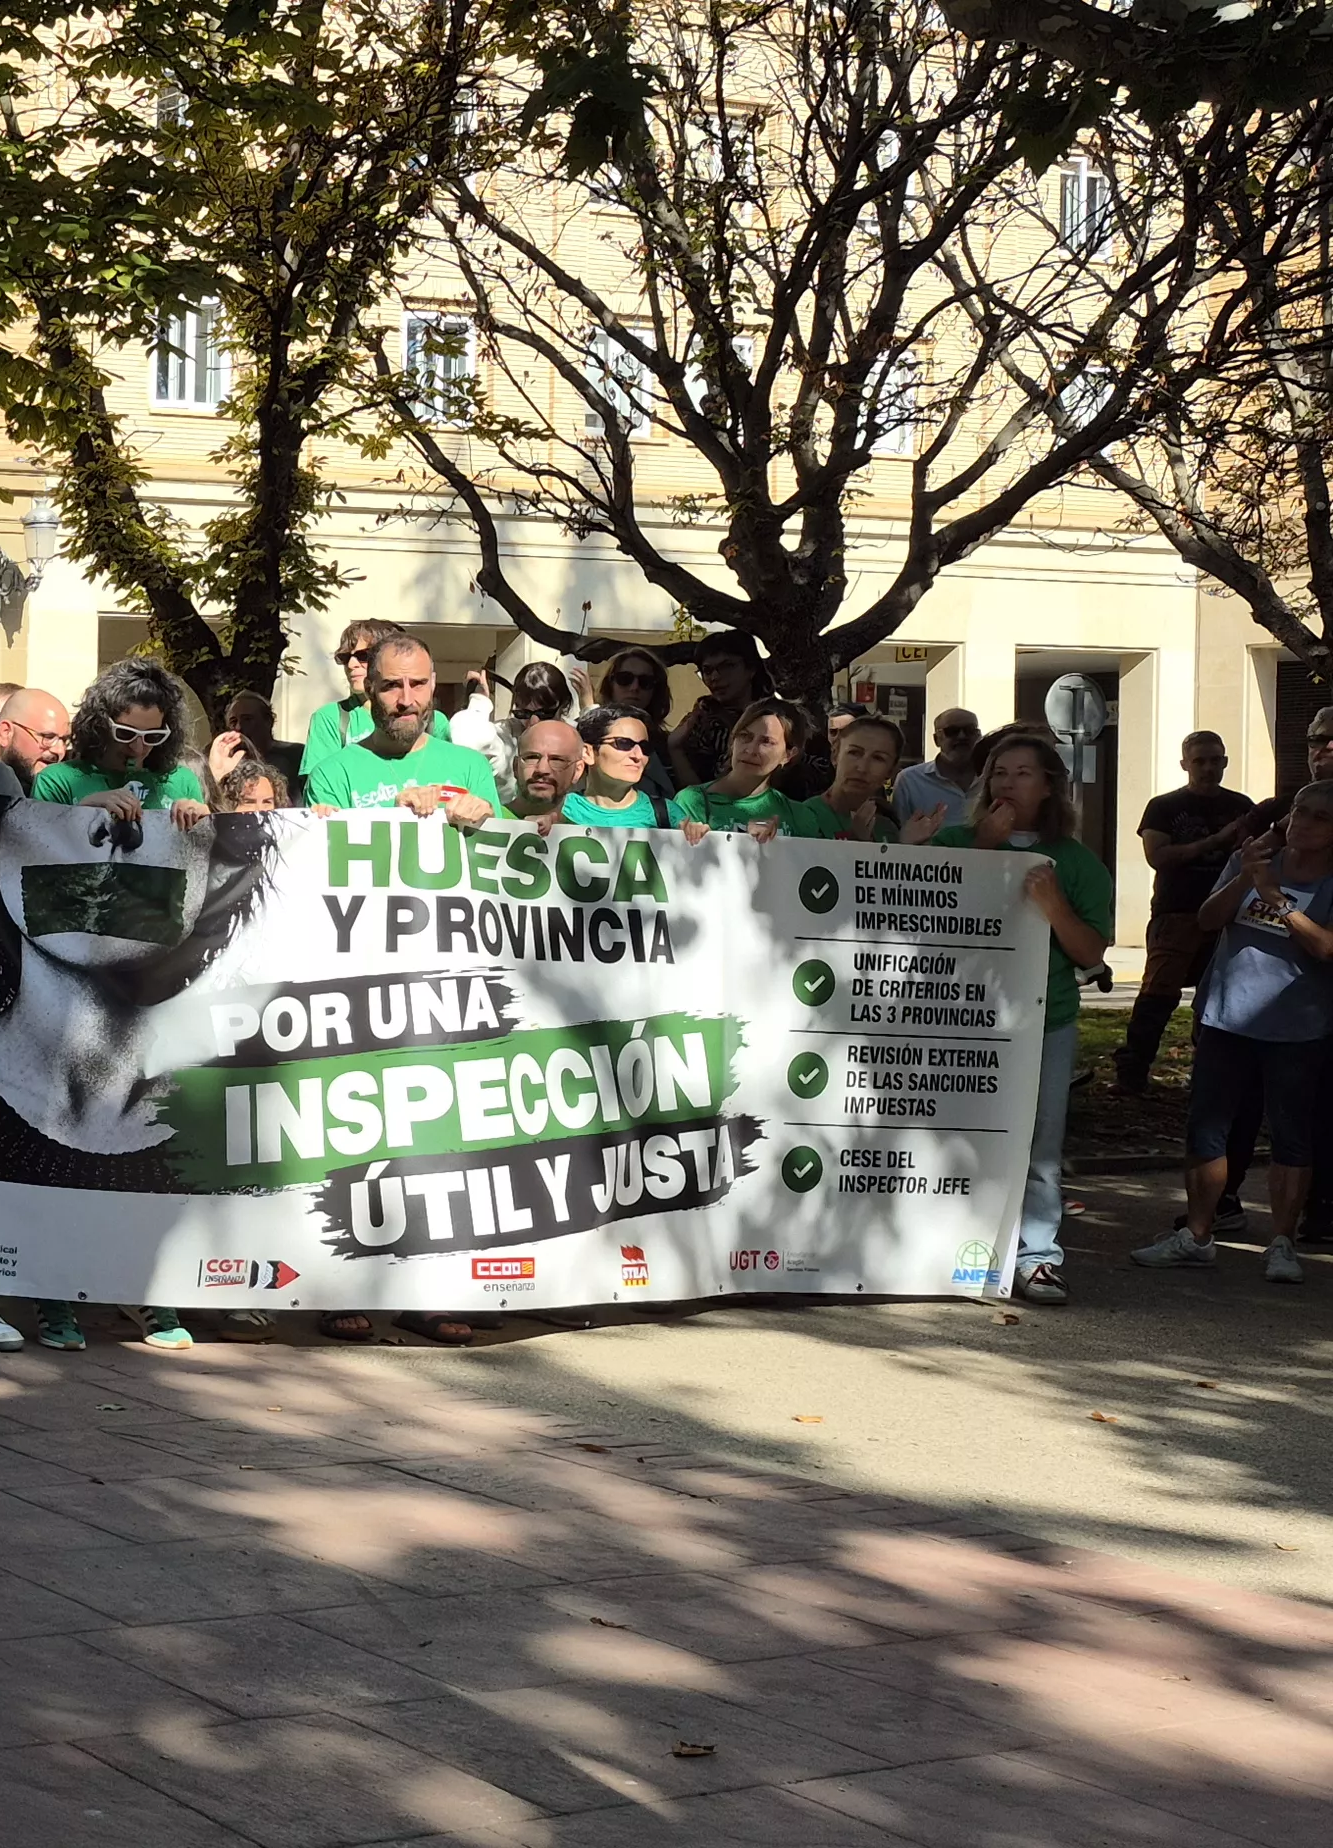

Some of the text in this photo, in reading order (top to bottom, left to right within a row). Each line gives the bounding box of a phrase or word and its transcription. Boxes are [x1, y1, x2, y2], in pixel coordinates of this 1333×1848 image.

[326, 820, 669, 903] HUESCA
[854, 860, 963, 884] ELIMINACIÓN
[855, 884, 958, 909] DE MÍNIMOS
[322, 895, 675, 964] Y PROVINCIA
[856, 911, 1002, 937] IMPRESCINDIBLES
[854, 952, 956, 975] UNIFICACIÓN
[852, 979, 986, 1002] DE CRITERIOS EN
[210, 976, 500, 1057] POR UNA
[851, 1003, 996, 1028] LAS 3 PROVINCIAS
[847, 1043, 1000, 1069] REVISIÓN EXTERNA
[224, 1021, 712, 1166] INSPECCIÓN
[846, 1071, 998, 1093] DE LAS SANCIONES
[844, 1096, 937, 1117] IMPUESTAS
[840, 1149, 916, 1169] CESE DEL
[350, 1124, 735, 1247] ÚTIL Y JUSTA
[838, 1174, 970, 1195] INSPECTOR JEFE
[12, 1259, 18, 1267] y
[206, 1259, 245, 1273] CGT
[476, 1261, 521, 1276] CCOO
[729, 1250, 761, 1270] UGT
[483, 1281, 535, 1292] enseñanza
[951, 1269, 1000, 1282] ANPE
